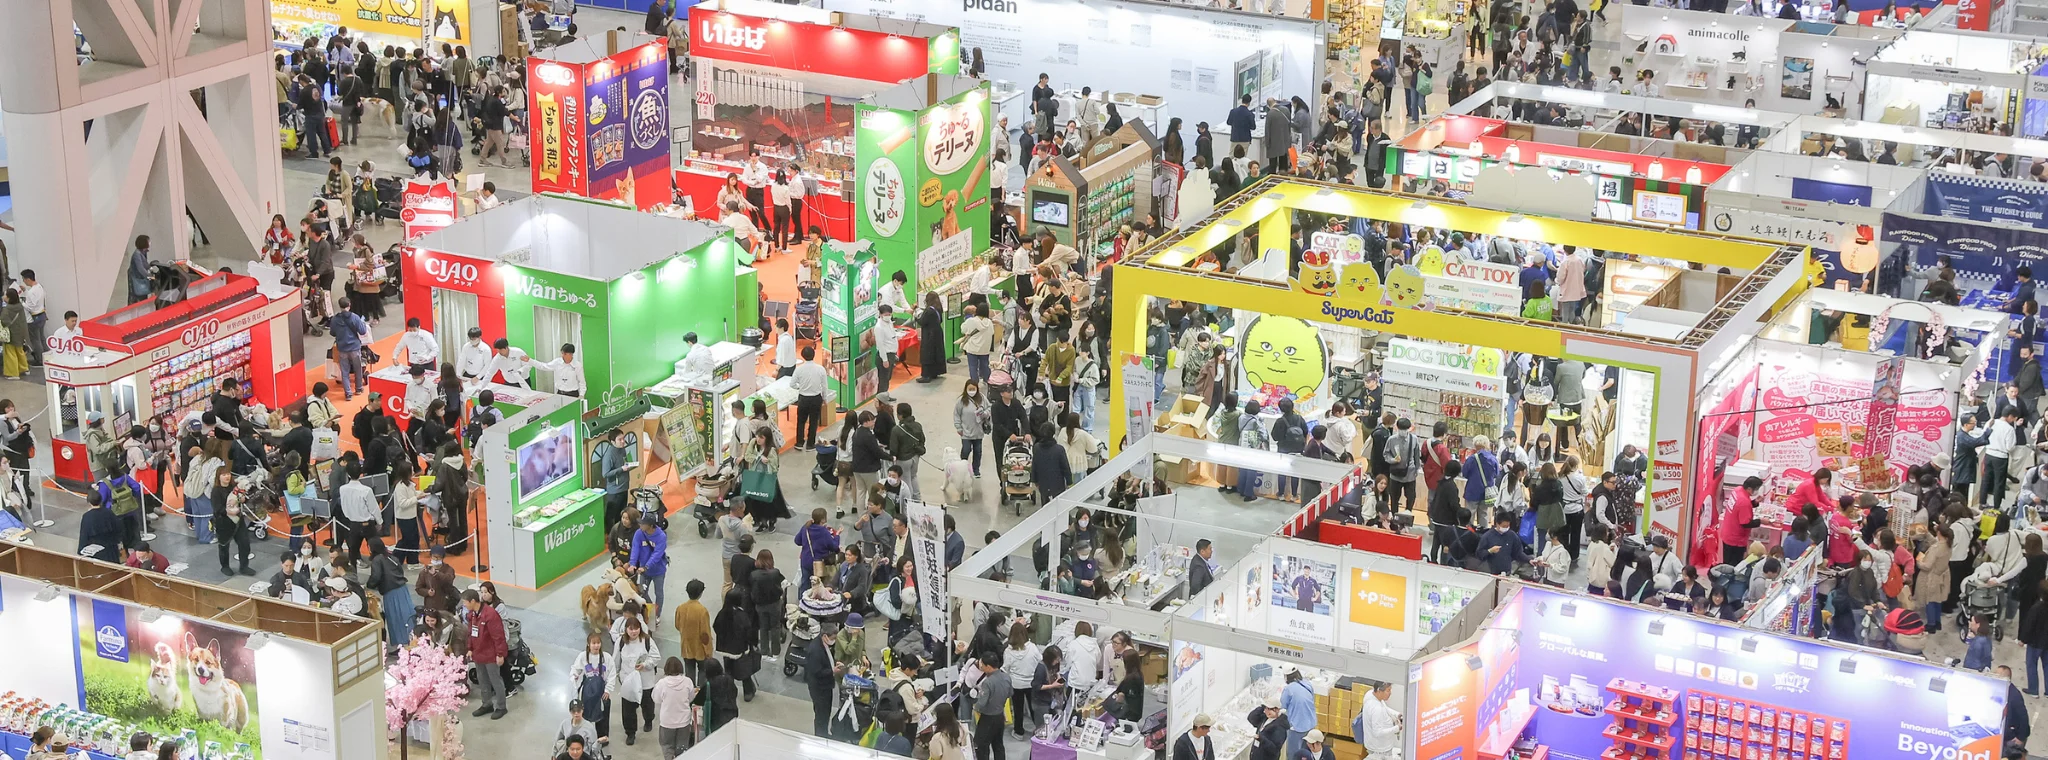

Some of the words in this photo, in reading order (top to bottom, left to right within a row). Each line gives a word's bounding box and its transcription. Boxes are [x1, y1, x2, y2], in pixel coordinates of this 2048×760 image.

[702, 20, 767, 50] いなば
[1688, 28, 1750, 41] animacolle
[696, 91, 715, 105] 220
[638, 95, 659, 129] 魚
[934, 131, 974, 165] テリーヌ
[873, 170, 885, 224] テリーヌ
[1602, 182, 1617, 197] 場
[1982, 205, 1993, 214] THE
[2025, 211, 2043, 220] GUIDE
[1314, 235, 1339, 248] CAT
[1795, 230, 1829, 244] たむろ
[1901, 235, 1925, 244] Diara
[1959, 243, 1984, 252] Diara
[2019, 251, 2044, 260] Diara
[425, 258, 478, 282] CIAO
[1445, 263, 1478, 279] CAT
[1482, 267, 1515, 284] TOY
[1321, 301, 1395, 325] SuperCat
[182, 320, 219, 348] CIAO
[47, 337, 84, 354] CIAO
[1391, 344, 1433, 364] DOG
[1436, 352, 1471, 369] TOY
[1765, 417, 1809, 432] 肉アレルギー
[1875, 409, 1896, 458] 真鯛
[1025, 599, 1081, 613] CAスキンケアセオリー
[1379, 601, 1395, 609] Pets
[1901, 721, 1950, 738] Innovation
[1897, 733, 1990, 760] Beyond
